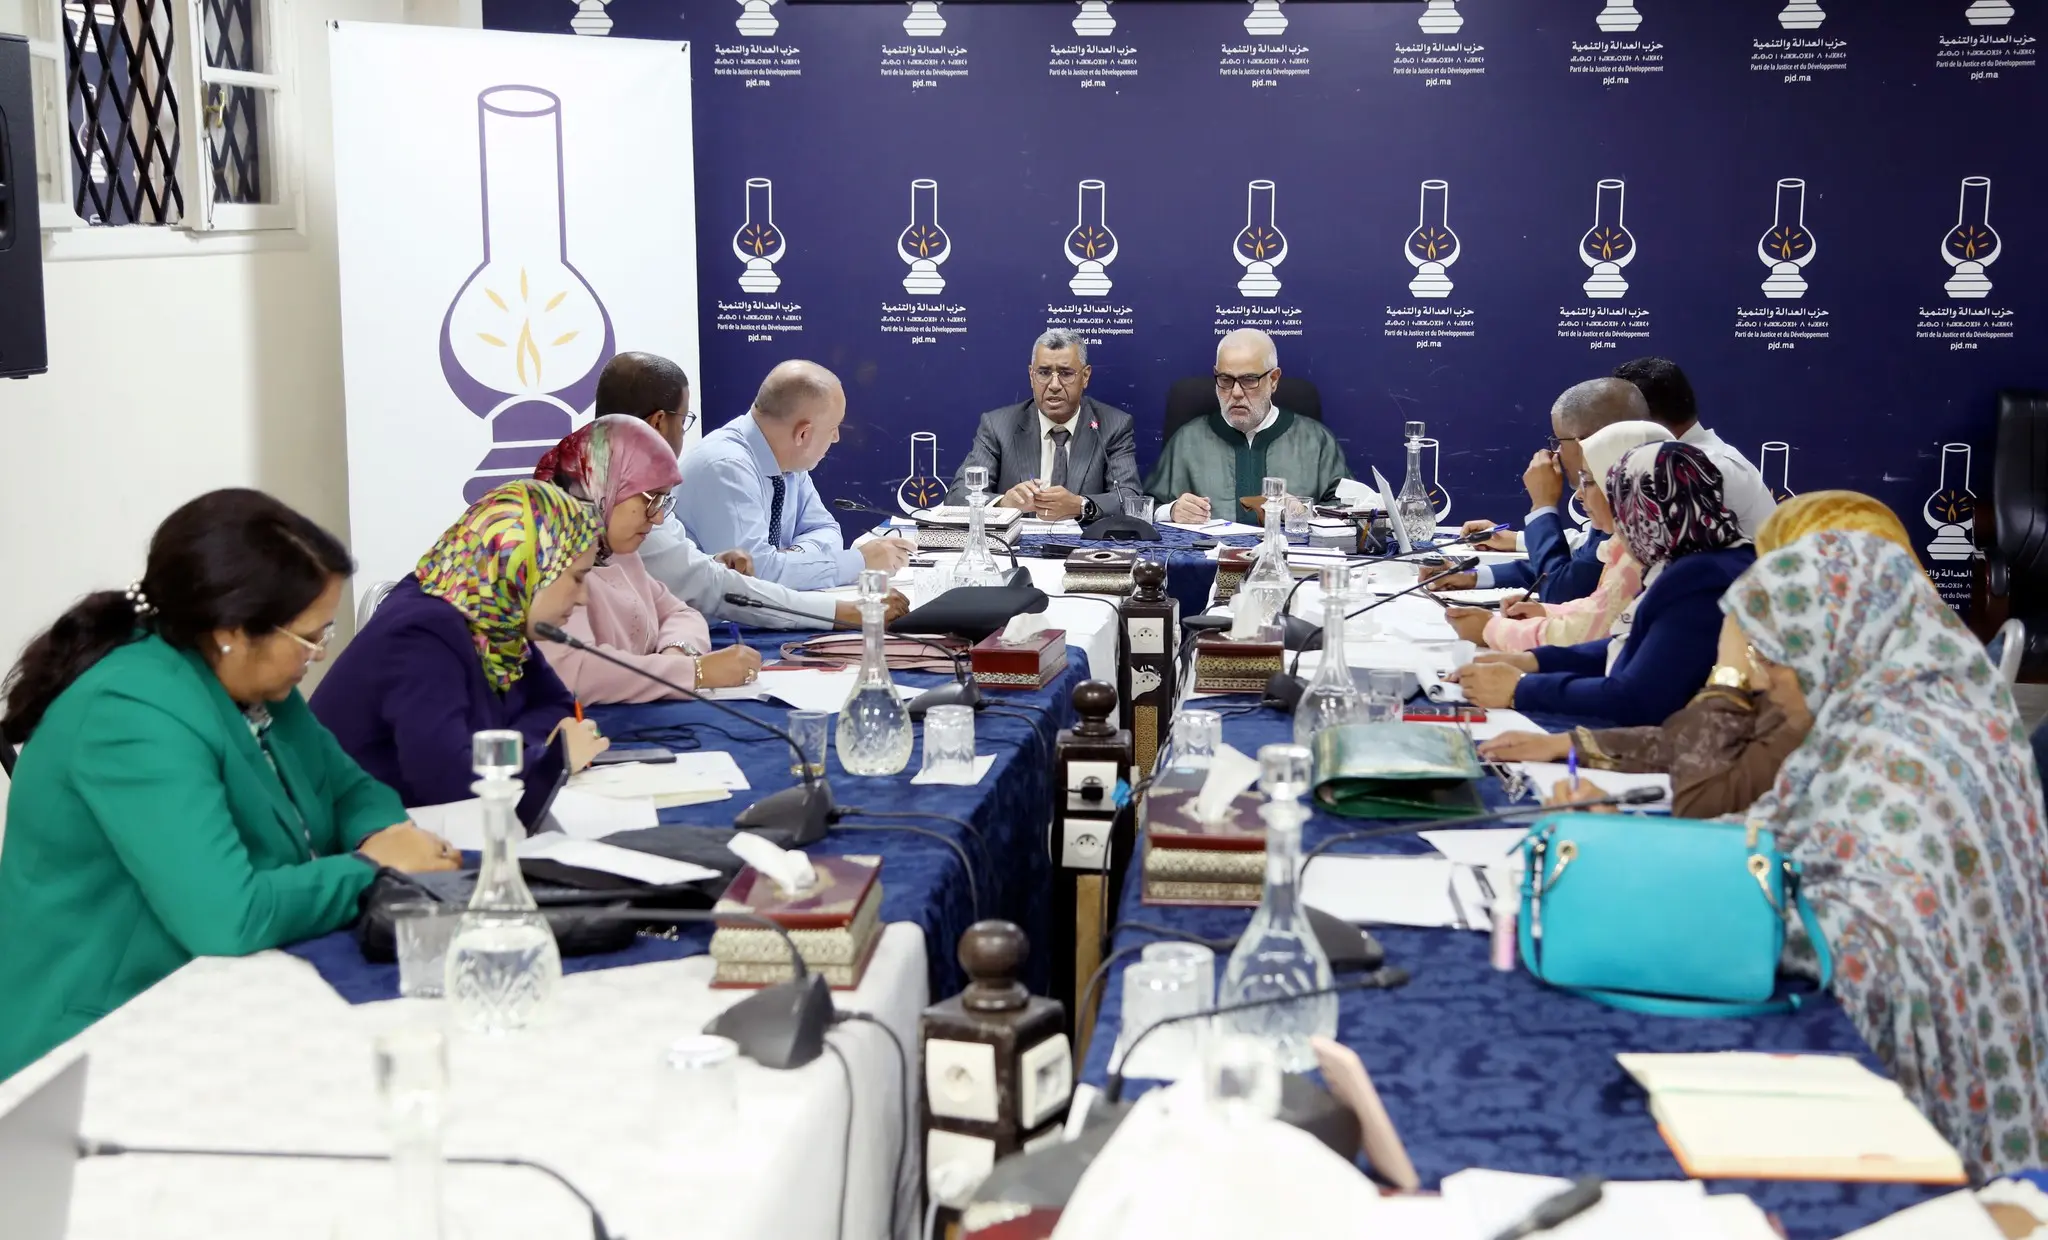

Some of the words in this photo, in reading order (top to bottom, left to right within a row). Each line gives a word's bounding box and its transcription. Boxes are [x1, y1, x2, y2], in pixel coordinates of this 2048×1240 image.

[1793, 38, 1823, 47] العدالة
[1940, 36, 1978, 46] والتنمية
[1980, 35, 2011, 43] العدالة
[2013, 35, 2036, 45] حزب
[1258, 44, 1287, 52] العدالة
[1396, 43, 1431, 54] والتنمية
[1433, 43, 1462, 51] العدالة
[1572, 41, 1608, 52] والتنمية
[1610, 41, 1640, 49] العدالة
[1642, 41, 1663, 52] حزب
[1754, 39, 1790, 50] والتنمية
[1825, 39, 1847, 49] حزب
[715, 45, 749, 56] والتنمية
[751, 45, 778, 53] العدالة
[780, 46, 799, 56] حزب
[882, 45, 916, 56] والتنمية
[918, 45, 946, 53] العدالة
[947, 46, 967, 56] حزب
[1051, 45, 1085, 56] والتنمية
[1087, 45, 1115, 53] العدالة
[1117, 46, 1137, 56] حزب
[1222, 44, 1256, 55] والتنمية
[1289, 45, 1309, 55] حزب
[1464, 44, 1484, 54] حزب
[1785, 74, 1811, 83] pjd.ma
[1971, 71, 1998, 80] pjd.ma
[746, 79, 770, 87] pjd.ma
[913, 79, 936, 88] pjd.ma
[1081, 79, 1105, 88] pjd.ma
[1252, 79, 1276, 87] pjd.ma
[1426, 78, 1451, 86] pjd.ma
[1603, 76, 1629, 85] pjd.ma
[718, 301, 751, 311] والتنمية
[753, 301, 780, 309] العدالة
[782, 302, 801, 312] حزب
[882, 303, 916, 313] والتنمية
[917, 303, 945, 311] العدالة
[946, 304, 966, 314] حزب
[1048, 304, 1082, 315] والتنمية
[1083, 304, 1111, 312] العدالة
[1252, 305, 1280, 313] العدالة
[1113, 306, 1132, 315] حزب
[1216, 305, 1250, 316] والتنمية
[1282, 307, 1302, 316] حزب
[1387, 306, 1421, 317] والتنمية
[1423, 306, 1452, 314] العدالة
[1454, 308, 1474, 317] حزب
[1560, 307, 1595, 318] والتنمية
[1597, 307, 1627, 315] العدالة
[1629, 308, 1649, 318] حزب
[1738, 307, 1774, 318] والتنمية
[1776, 307, 1806, 315] العدالة
[1808, 308, 1829, 318] حزب
[1919, 307, 1957, 318] والتنمية
[1959, 307, 1990, 315] العدالة
[1992, 308, 2013, 318] حزب
[748, 334, 772, 342] pjd.ma
[912, 336, 936, 344] pjd.ma
[1417, 340, 1441, 348] pjd.ma
[1591, 341, 1615, 349] pjd.ma
[1768, 342, 1794, 350] pjd.ma
[1951, 342, 1977, 350] pjd.ma
[1941, 568, 1972, 577] العدالة
